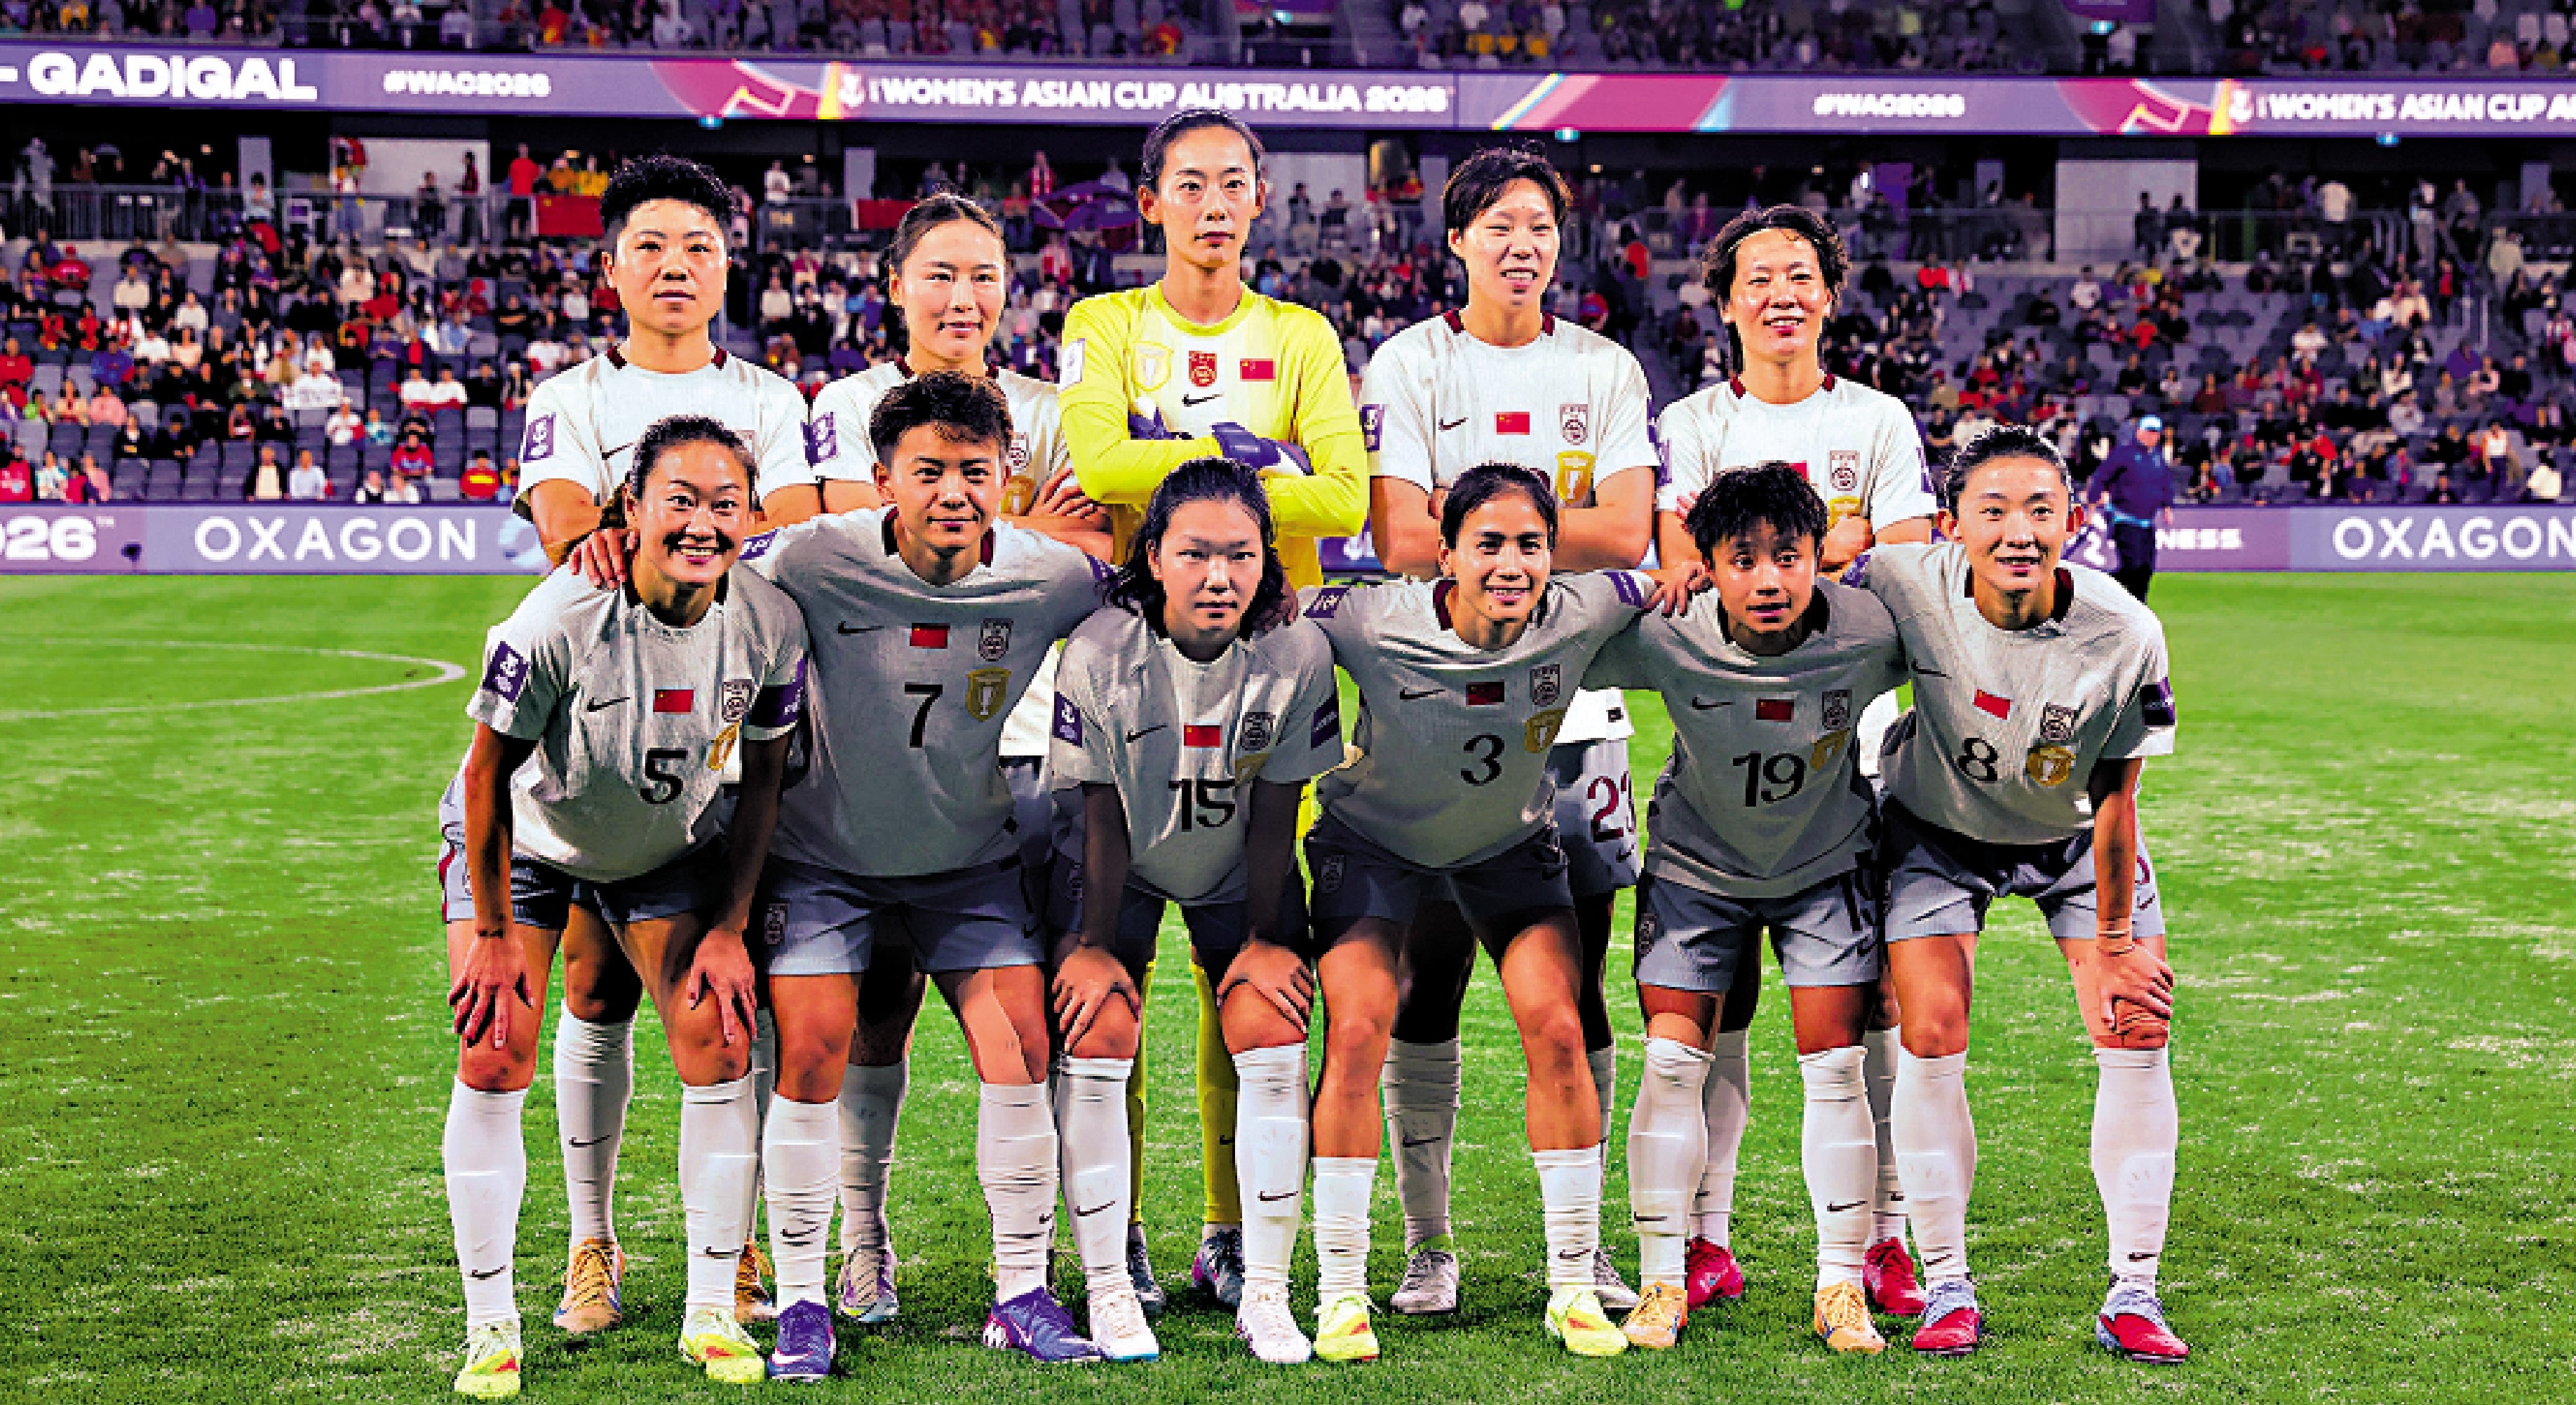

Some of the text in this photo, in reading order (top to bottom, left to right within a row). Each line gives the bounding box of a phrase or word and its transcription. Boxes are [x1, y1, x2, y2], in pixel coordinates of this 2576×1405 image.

[27, 52, 318, 101] GADIGAL
[383, 69, 552, 98] #WAC2026
[882, 77, 1017, 107] WOMEN'S
[1021, 80, 1110, 109] ASIAN
[1113, 81, 1177, 109] CUP
[1177, 82, 1363, 112] AUSTRALIA
[1364, 86, 1449, 112] 2026
[2267, 93, 2396, 121] WOMEN'S
[2399, 93, 2486, 121] ASIAN
[2486, 93, 2547, 121] CUP
[194, 516, 477, 562] OXAGON
[2333, 516, 2576, 560] OXAGON
[905, 683, 943, 748] 7
[639, 748, 688, 805] 5
[1460, 733, 1506, 787] 3
[1732, 750, 1805, 807] 19
[1958, 737, 1999, 782] 8
[1168, 778, 1236, 832] 15
